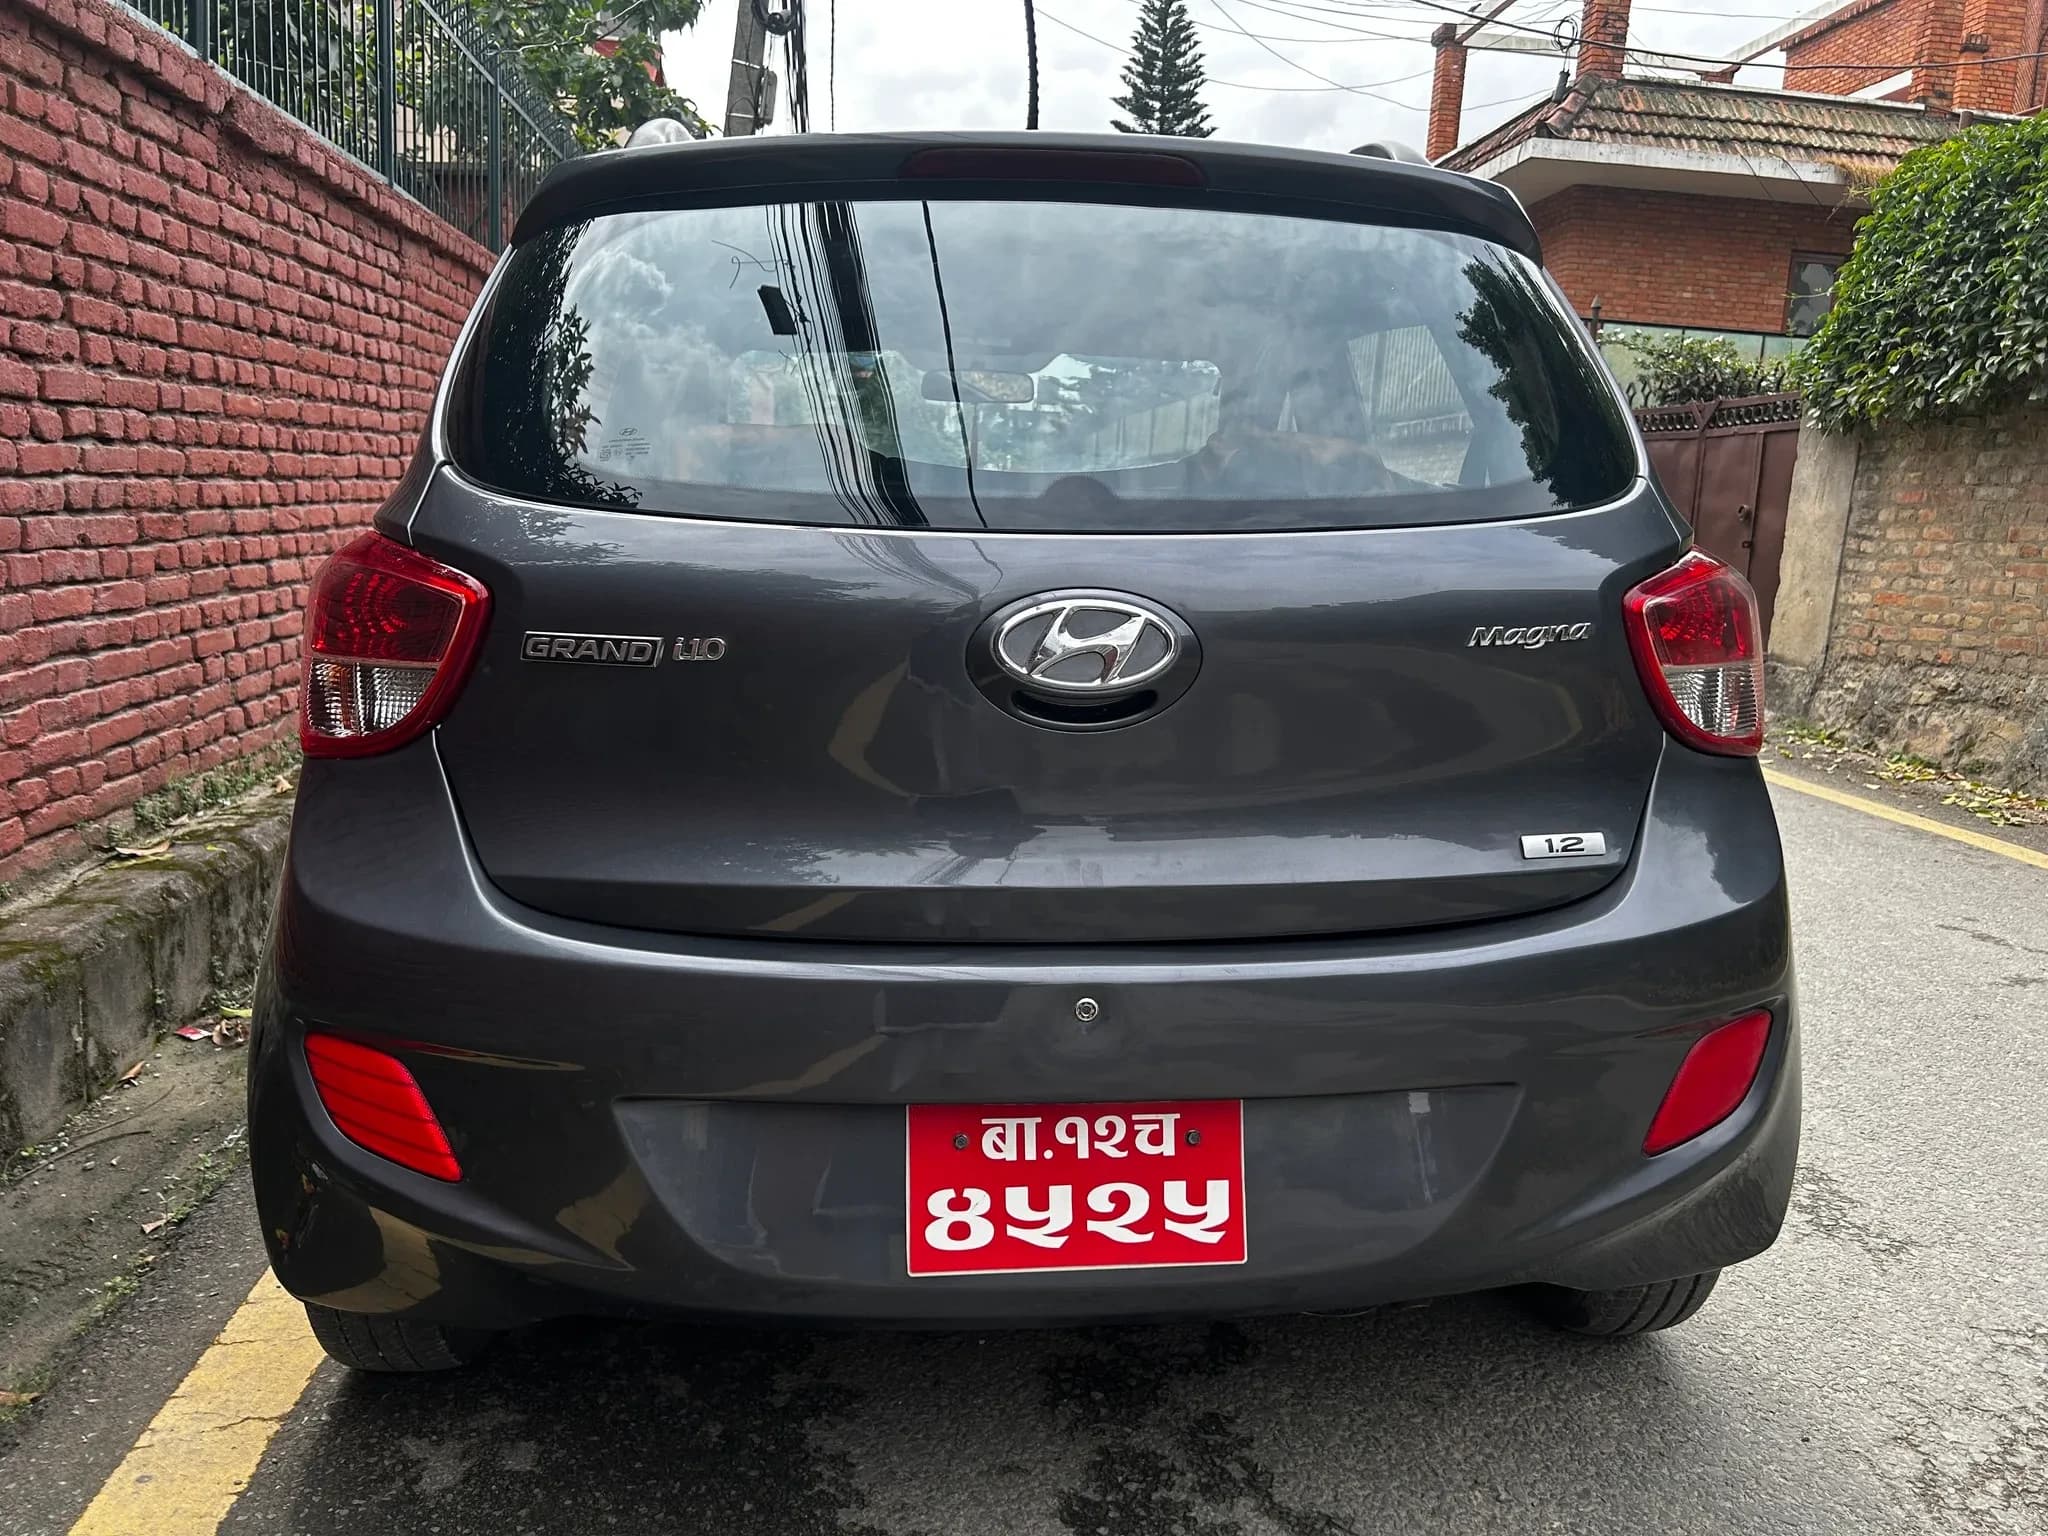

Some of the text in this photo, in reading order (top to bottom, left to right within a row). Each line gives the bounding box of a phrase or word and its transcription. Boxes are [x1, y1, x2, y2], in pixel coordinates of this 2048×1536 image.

[1466, 622, 1592, 649] Magna
[525, 636, 727, 662] GRAND i10
[1544, 836, 1585, 853] 1.2
[924, 1179, 1230, 1251] ४५२५
